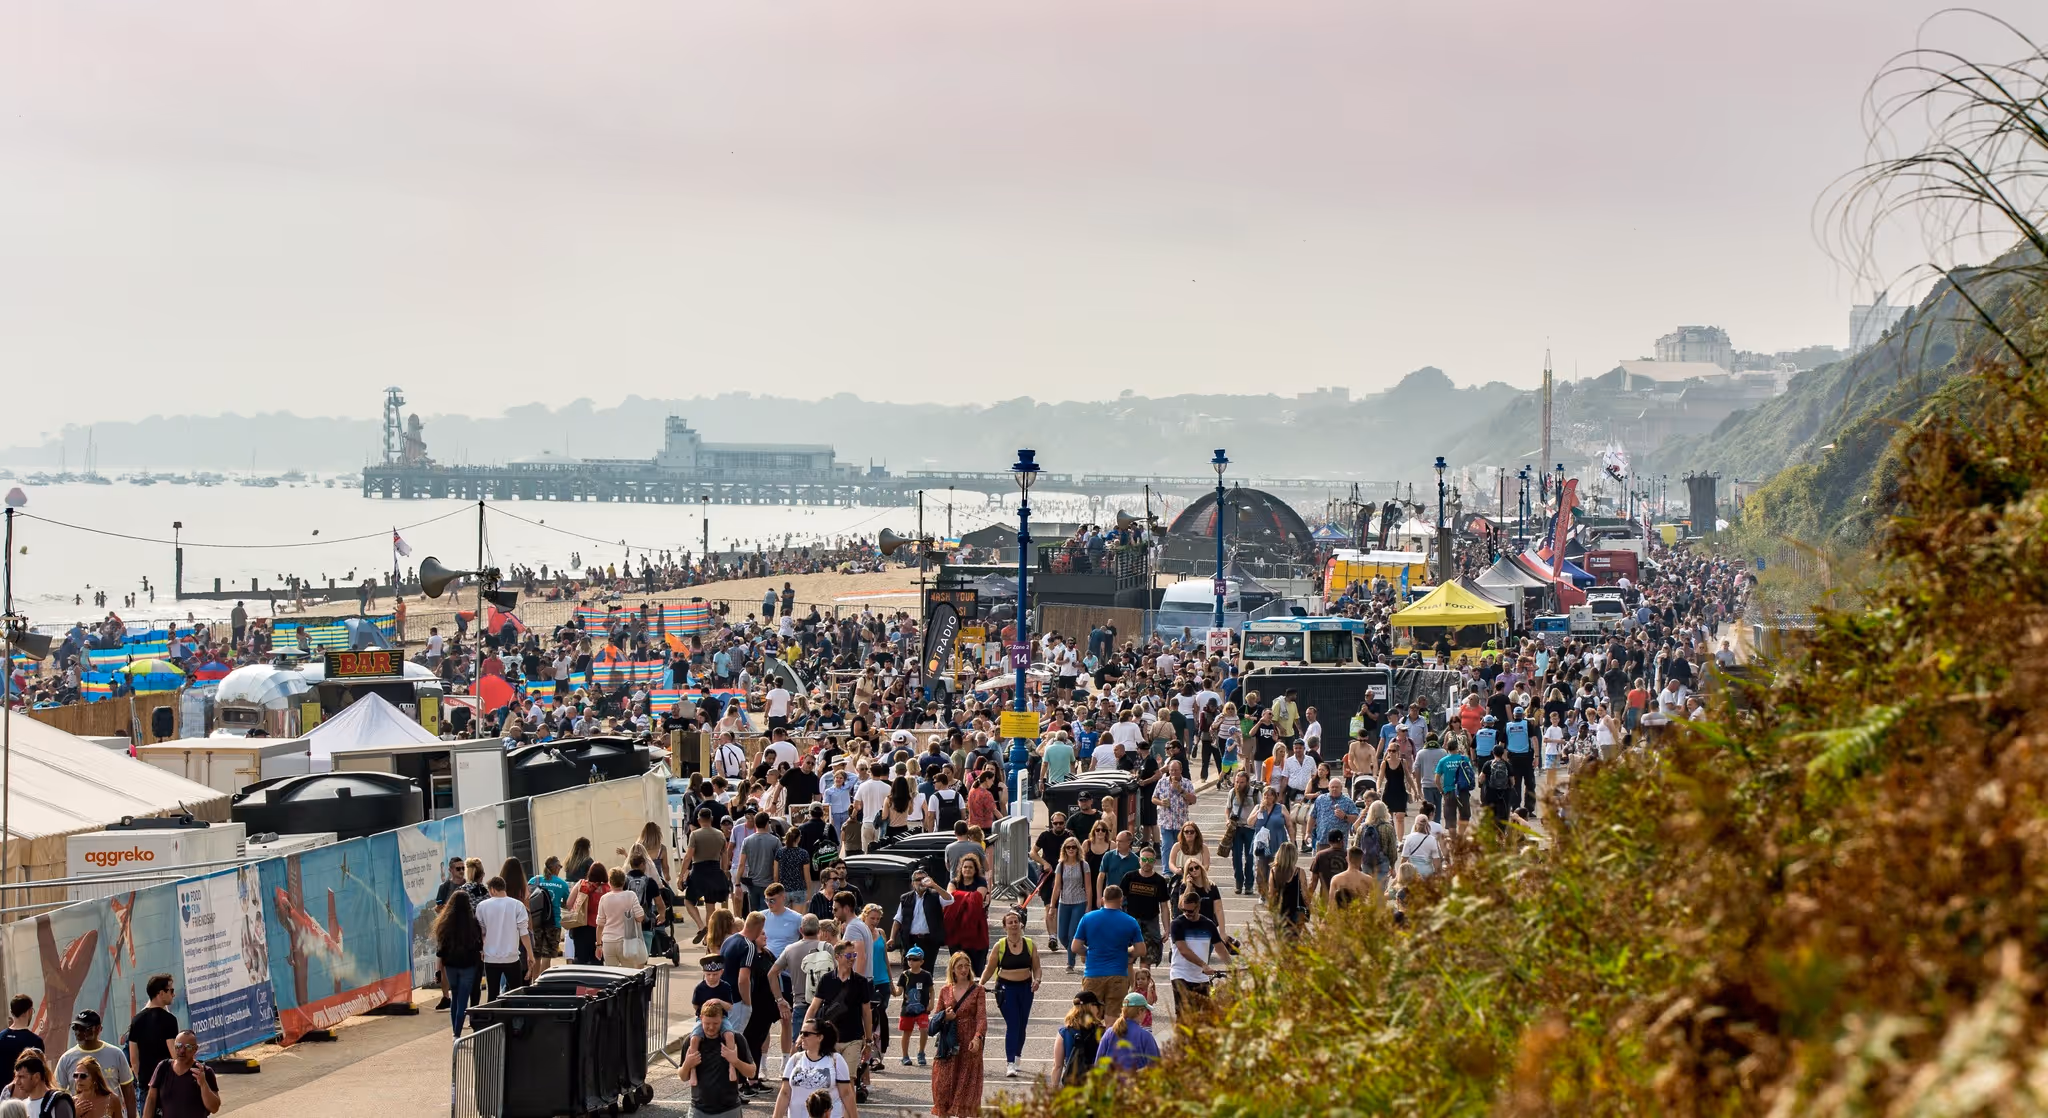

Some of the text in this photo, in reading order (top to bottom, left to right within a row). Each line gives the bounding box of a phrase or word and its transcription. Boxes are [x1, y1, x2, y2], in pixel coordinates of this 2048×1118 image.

[955, 592, 976, 602] YOUR
[1445, 602, 1475, 610] FOOD
[339, 651, 392, 675] BAR
[1014, 653, 1028, 665] 14
[84, 846, 155, 867] aggreko
[190, 890, 201, 901] FOOD
[191, 904, 201, 915] FUN
[192, 912, 216, 928] FRIENDSHIP
